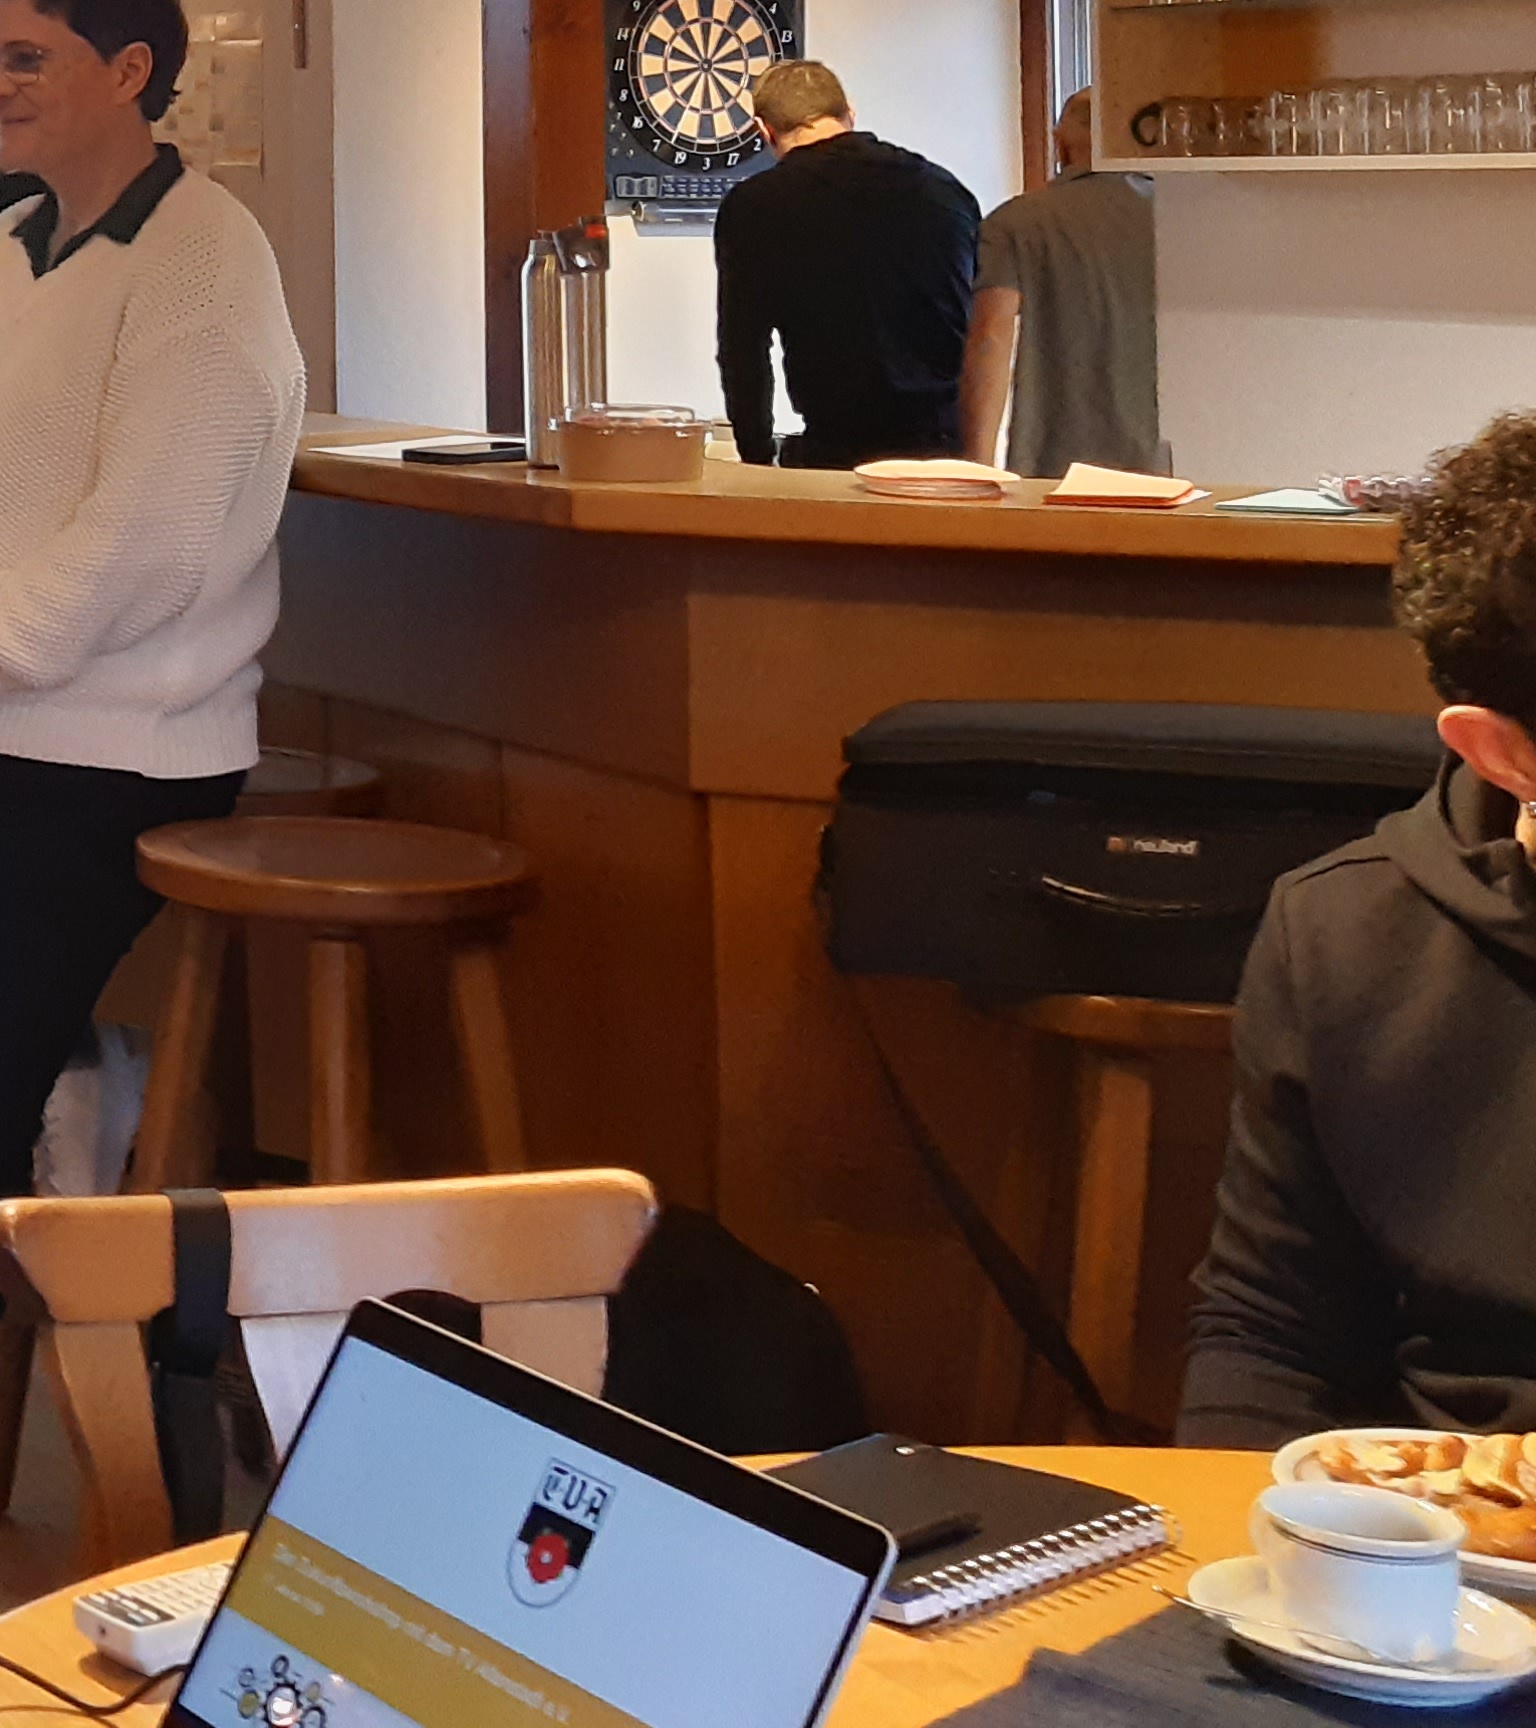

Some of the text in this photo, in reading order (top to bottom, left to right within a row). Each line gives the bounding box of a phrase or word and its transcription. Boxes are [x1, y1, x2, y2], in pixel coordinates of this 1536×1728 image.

[632, 0, 641, 12] 9
[768, 2, 778, 14] 4
[616, 27, 629, 41] 14
[781, 30, 793, 43] 13
[613, 58, 625, 71] 11
[619, 89, 628, 102] 8
[631, 116, 644, 129] 16
[652, 138, 662, 152] 7
[753, 138, 762, 151] 2
[674, 151, 687, 165] 19
[702, 157, 711, 170] 3
[726, 152, 740, 166] 17
